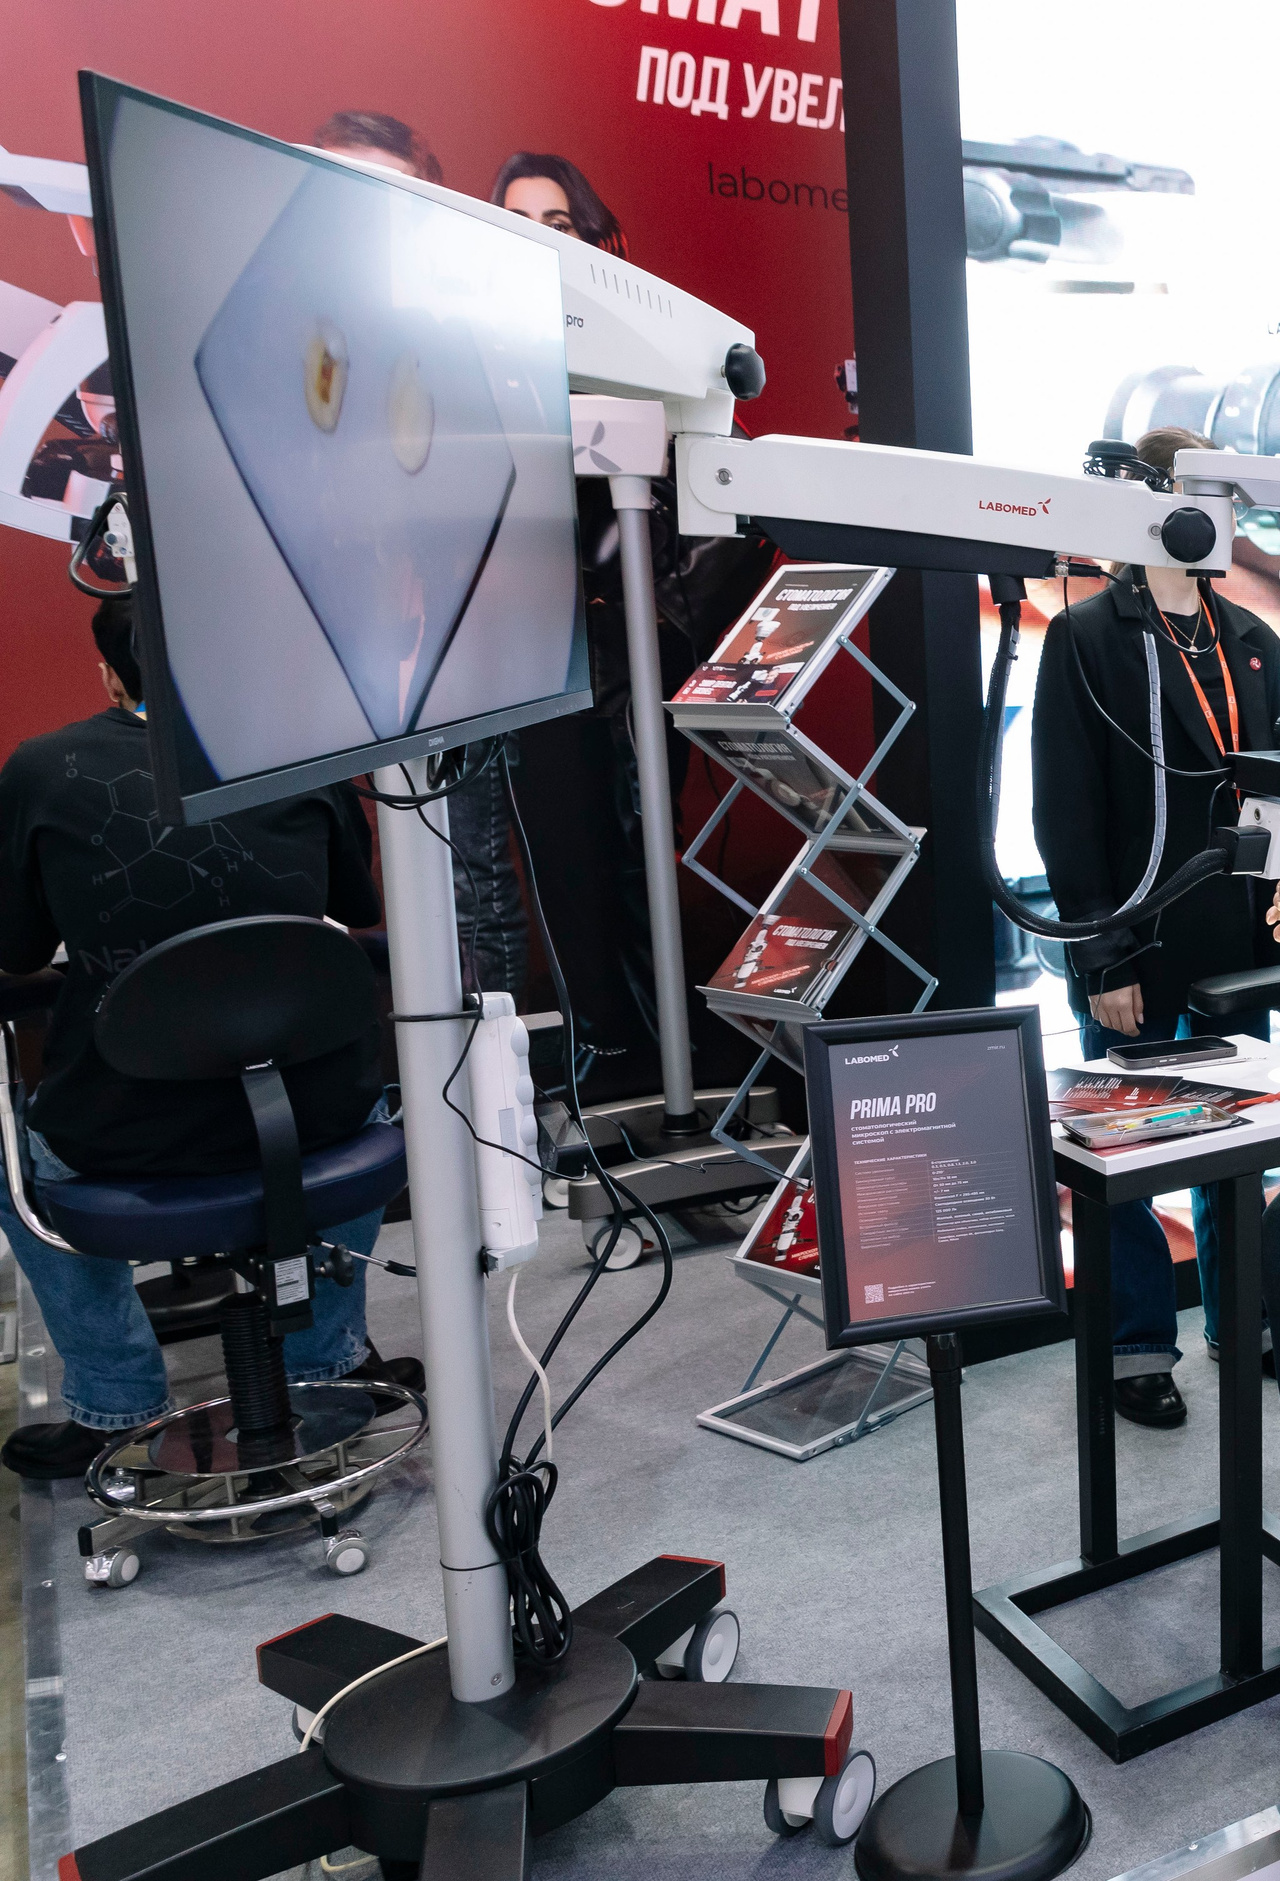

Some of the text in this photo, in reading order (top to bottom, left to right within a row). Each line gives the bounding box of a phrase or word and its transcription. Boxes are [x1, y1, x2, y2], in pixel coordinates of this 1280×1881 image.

[636, 45, 730, 121] ПОД
[978, 500, 1037, 517] LABOMED
[775, 588, 853, 602] СТОМАТОЛОГИЯ
[717, 741, 793, 754] СТОМАТОЛОГИЯ
[772, 925, 838, 941] СТОМАТОЛОГИЯ
[845, 1054, 890, 1065] LABOMED
[850, 1092, 937, 1120] PRIMA PRO
[851, 1119, 917, 1132] стоматологический
[851, 1128, 889, 1139] микроскоп
[894, 1122, 957, 1135] электромагнитной
[852, 1136, 885, 1145] системой
